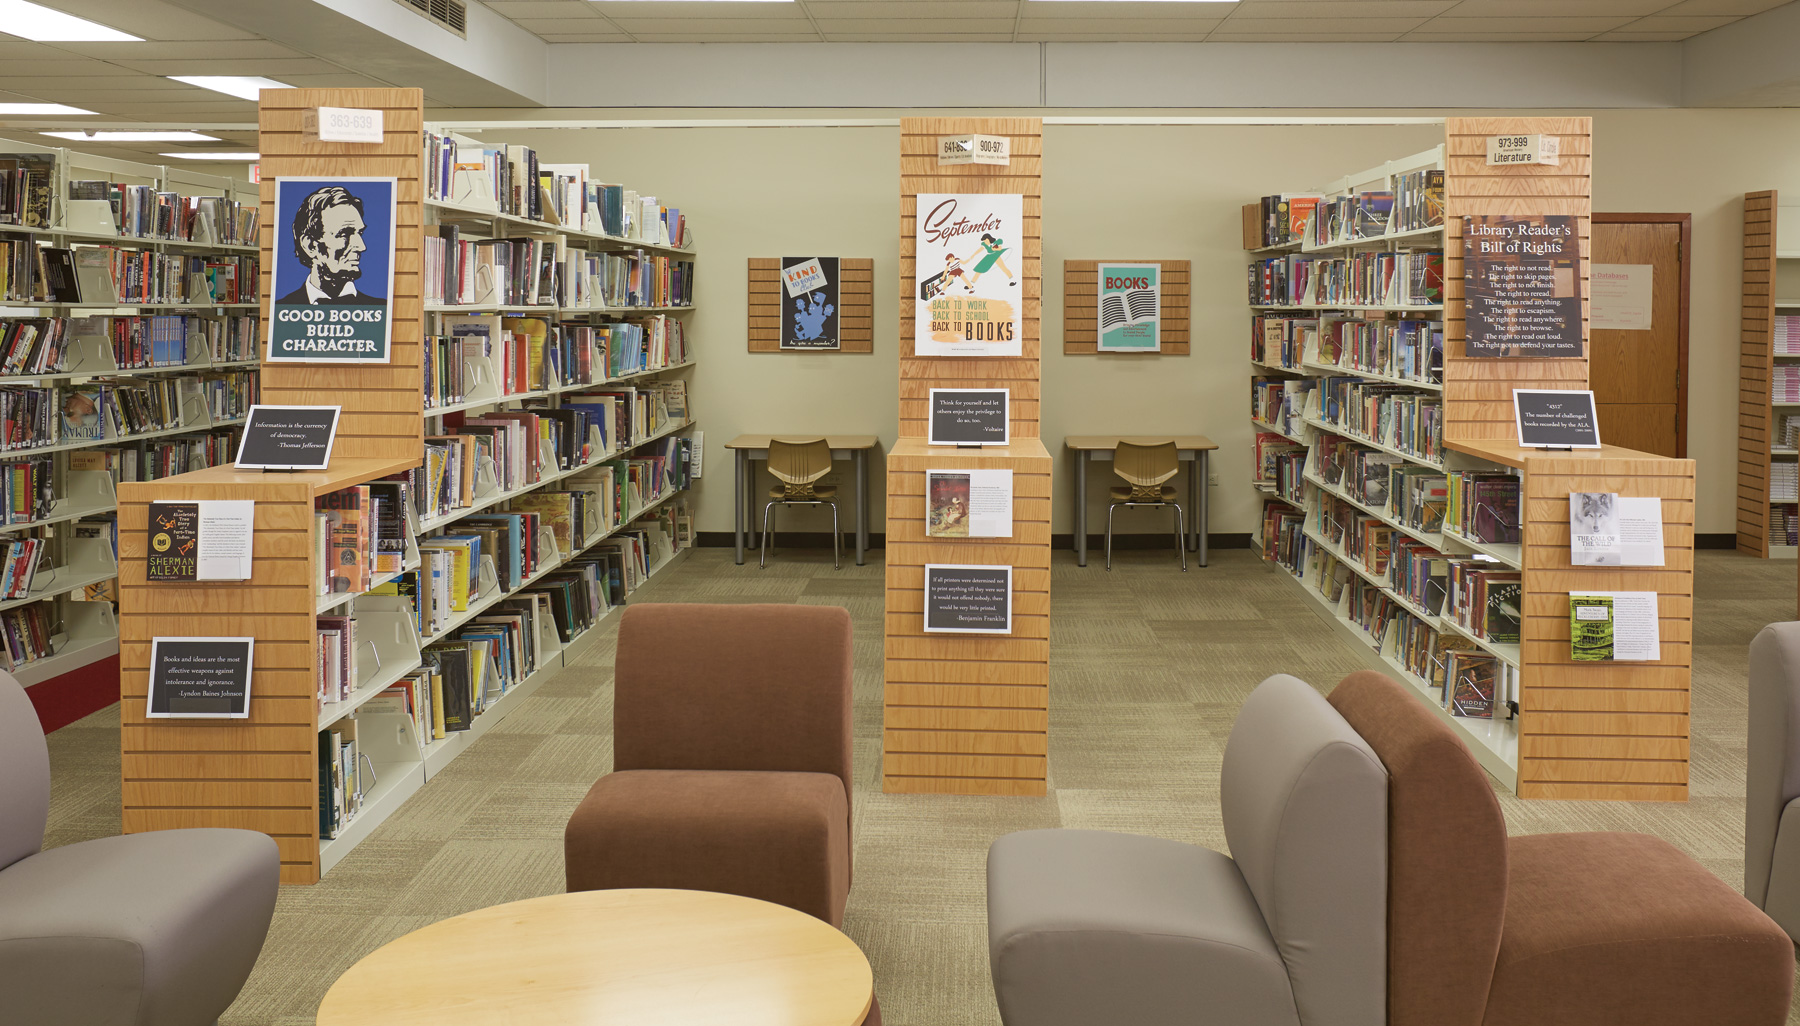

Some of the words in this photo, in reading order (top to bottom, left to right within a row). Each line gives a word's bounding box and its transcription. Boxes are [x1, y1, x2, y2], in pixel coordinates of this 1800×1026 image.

[330, 114, 372, 128] 363-639
[980, 140, 1003, 153] 900-972
[1499, 137, 1527, 148] 973-999
[1494, 153, 1531, 162] Literature
[924, 199, 1001, 247] September
[1471, 224, 1514, 238] Library
[1518, 224, 1570, 236] Reader’s
[1481, 242, 1502, 252] Bill
[1506, 242, 1520, 252] of
[1523, 242, 1562, 255] Rights
[788, 266, 817, 282] KIND
[1106, 277, 1148, 289] BOOKS
[933, 300, 949, 309] BACK
[954, 301, 961, 309] TO
[967, 301, 987, 310] WORK
[279, 310, 325, 322] GOOD
[329, 310, 382, 322] BOOKS
[933, 311, 949, 320] BACK
[954, 311, 961, 320] TO
[966, 312, 989, 320] SCHOOL
[307, 324, 354, 336] BUILD
[933, 322, 949, 331] BACK
[954, 322, 961, 331] TO
[966, 322, 1012, 341] BOOKS
[283, 339, 377, 352] CHARACTER
[63, 427, 98, 438] TRUMAN
[150, 557, 194, 565] SHERMAN
[150, 566, 194, 575] ALEXIE
[1490, 590, 1521, 607] FICTIO
